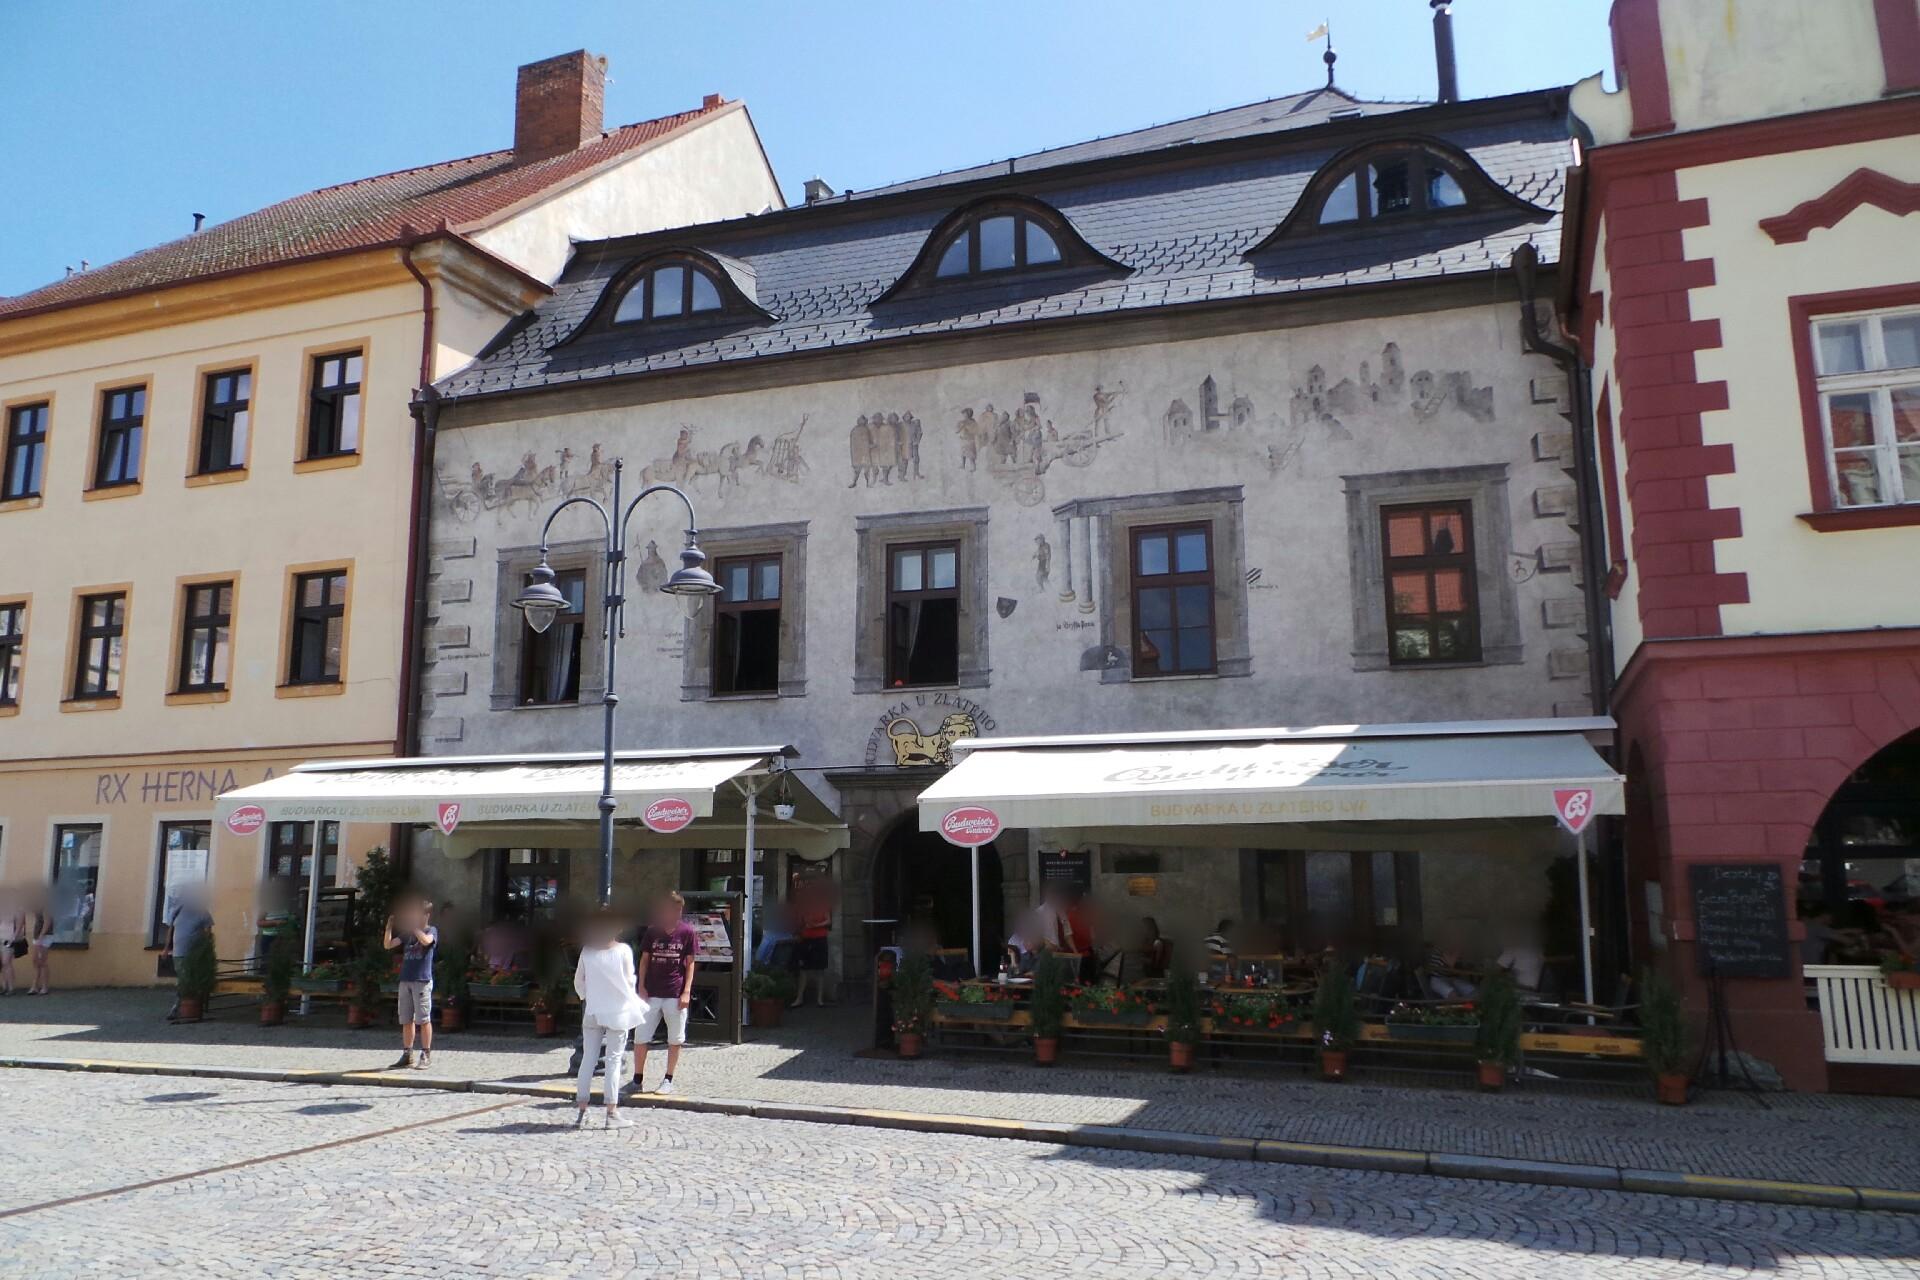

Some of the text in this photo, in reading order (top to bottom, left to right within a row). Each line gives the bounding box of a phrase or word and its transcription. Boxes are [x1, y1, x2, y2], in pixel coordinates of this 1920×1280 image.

[916, 695, 926, 706] U
[95, 772, 130, 804] RX
[142, 768, 239, 803] HERNA
[280, 805, 337, 816] BUDVARKA
[479, 802, 538, 815] BUDVARKA
[541, 802, 549, 813] U
[944, 815, 995, 833] Budweiser
